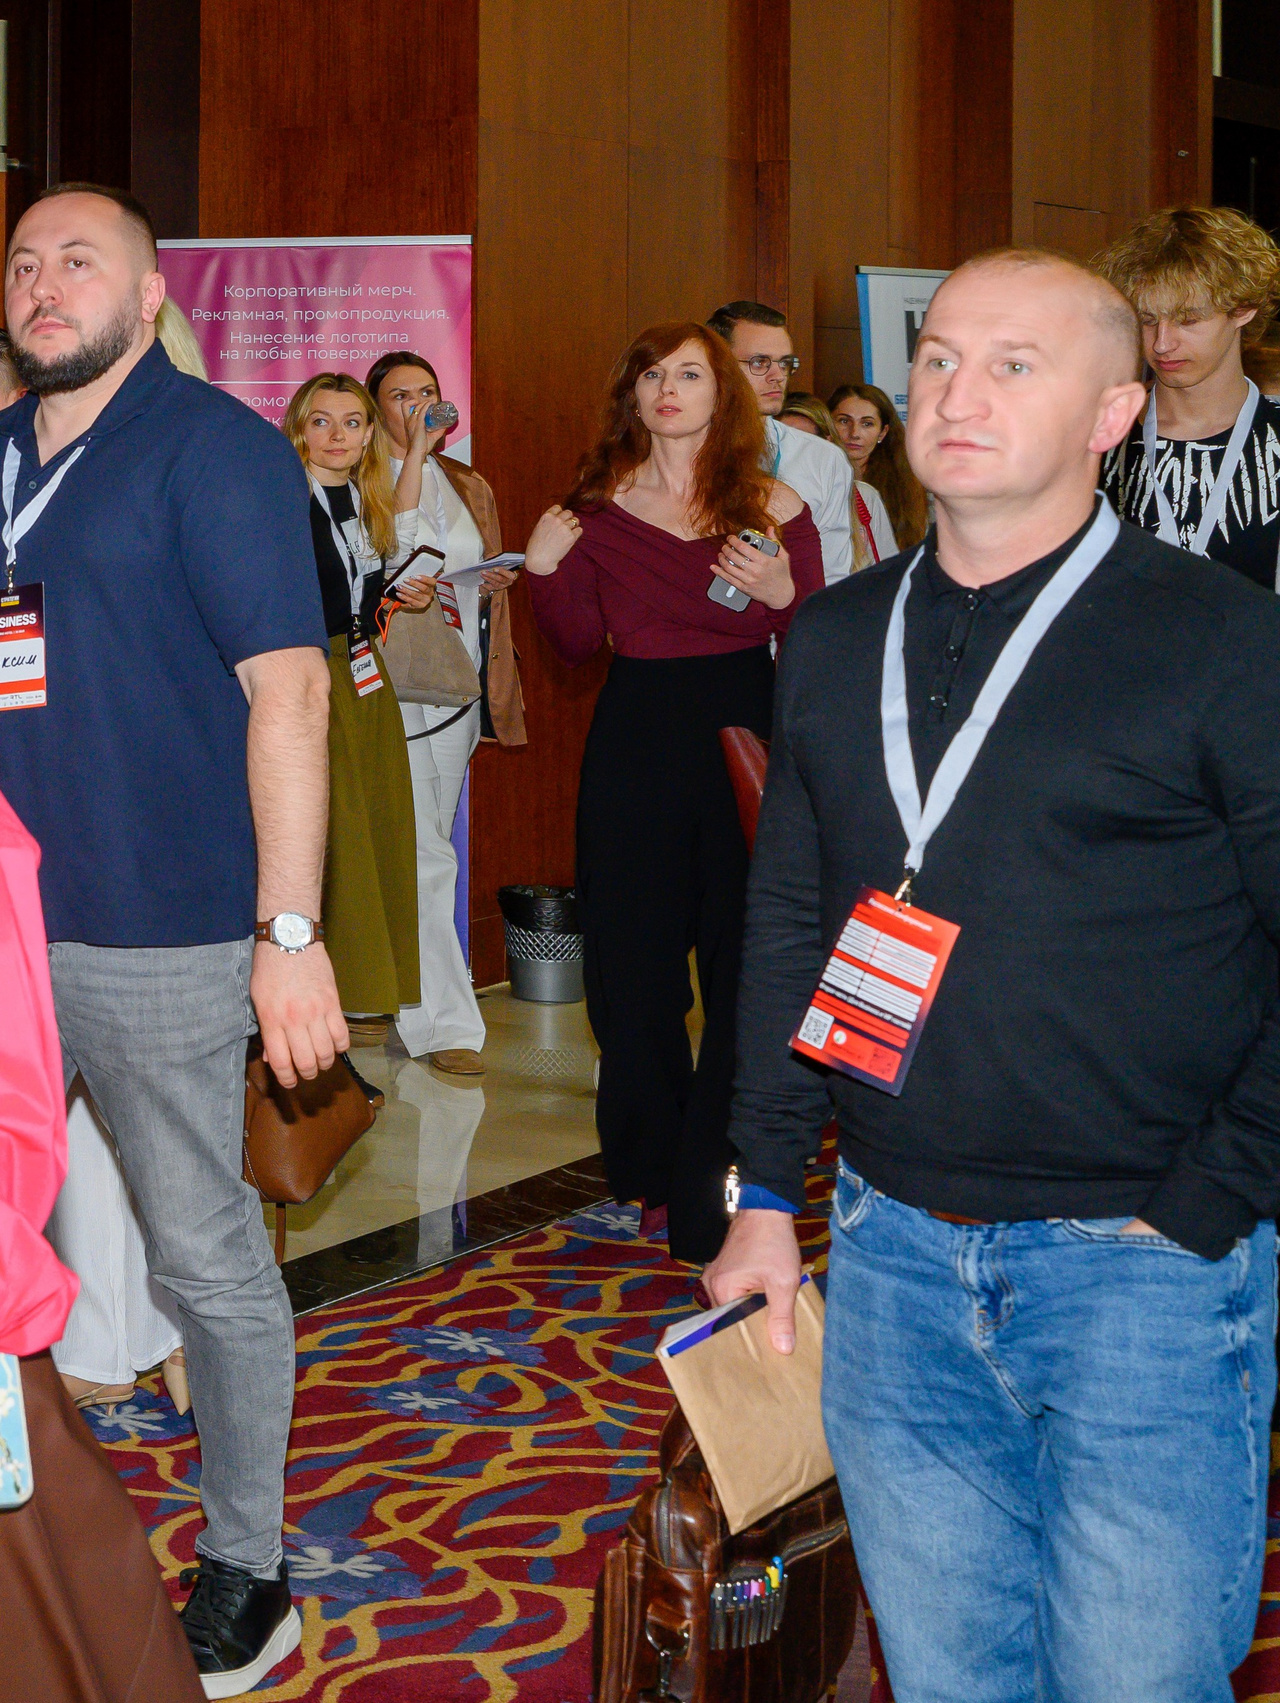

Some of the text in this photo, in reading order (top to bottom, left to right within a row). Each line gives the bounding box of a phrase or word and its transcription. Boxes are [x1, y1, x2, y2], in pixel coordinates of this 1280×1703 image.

[223, 283, 416, 300] Корпоративный мерч.
[192, 308, 450, 323] Рекламная, промопродукция.
[230, 331, 409, 344] Нанесение логотипа
[220, 349, 239, 361] на
[244, 346, 303, 360] любые
